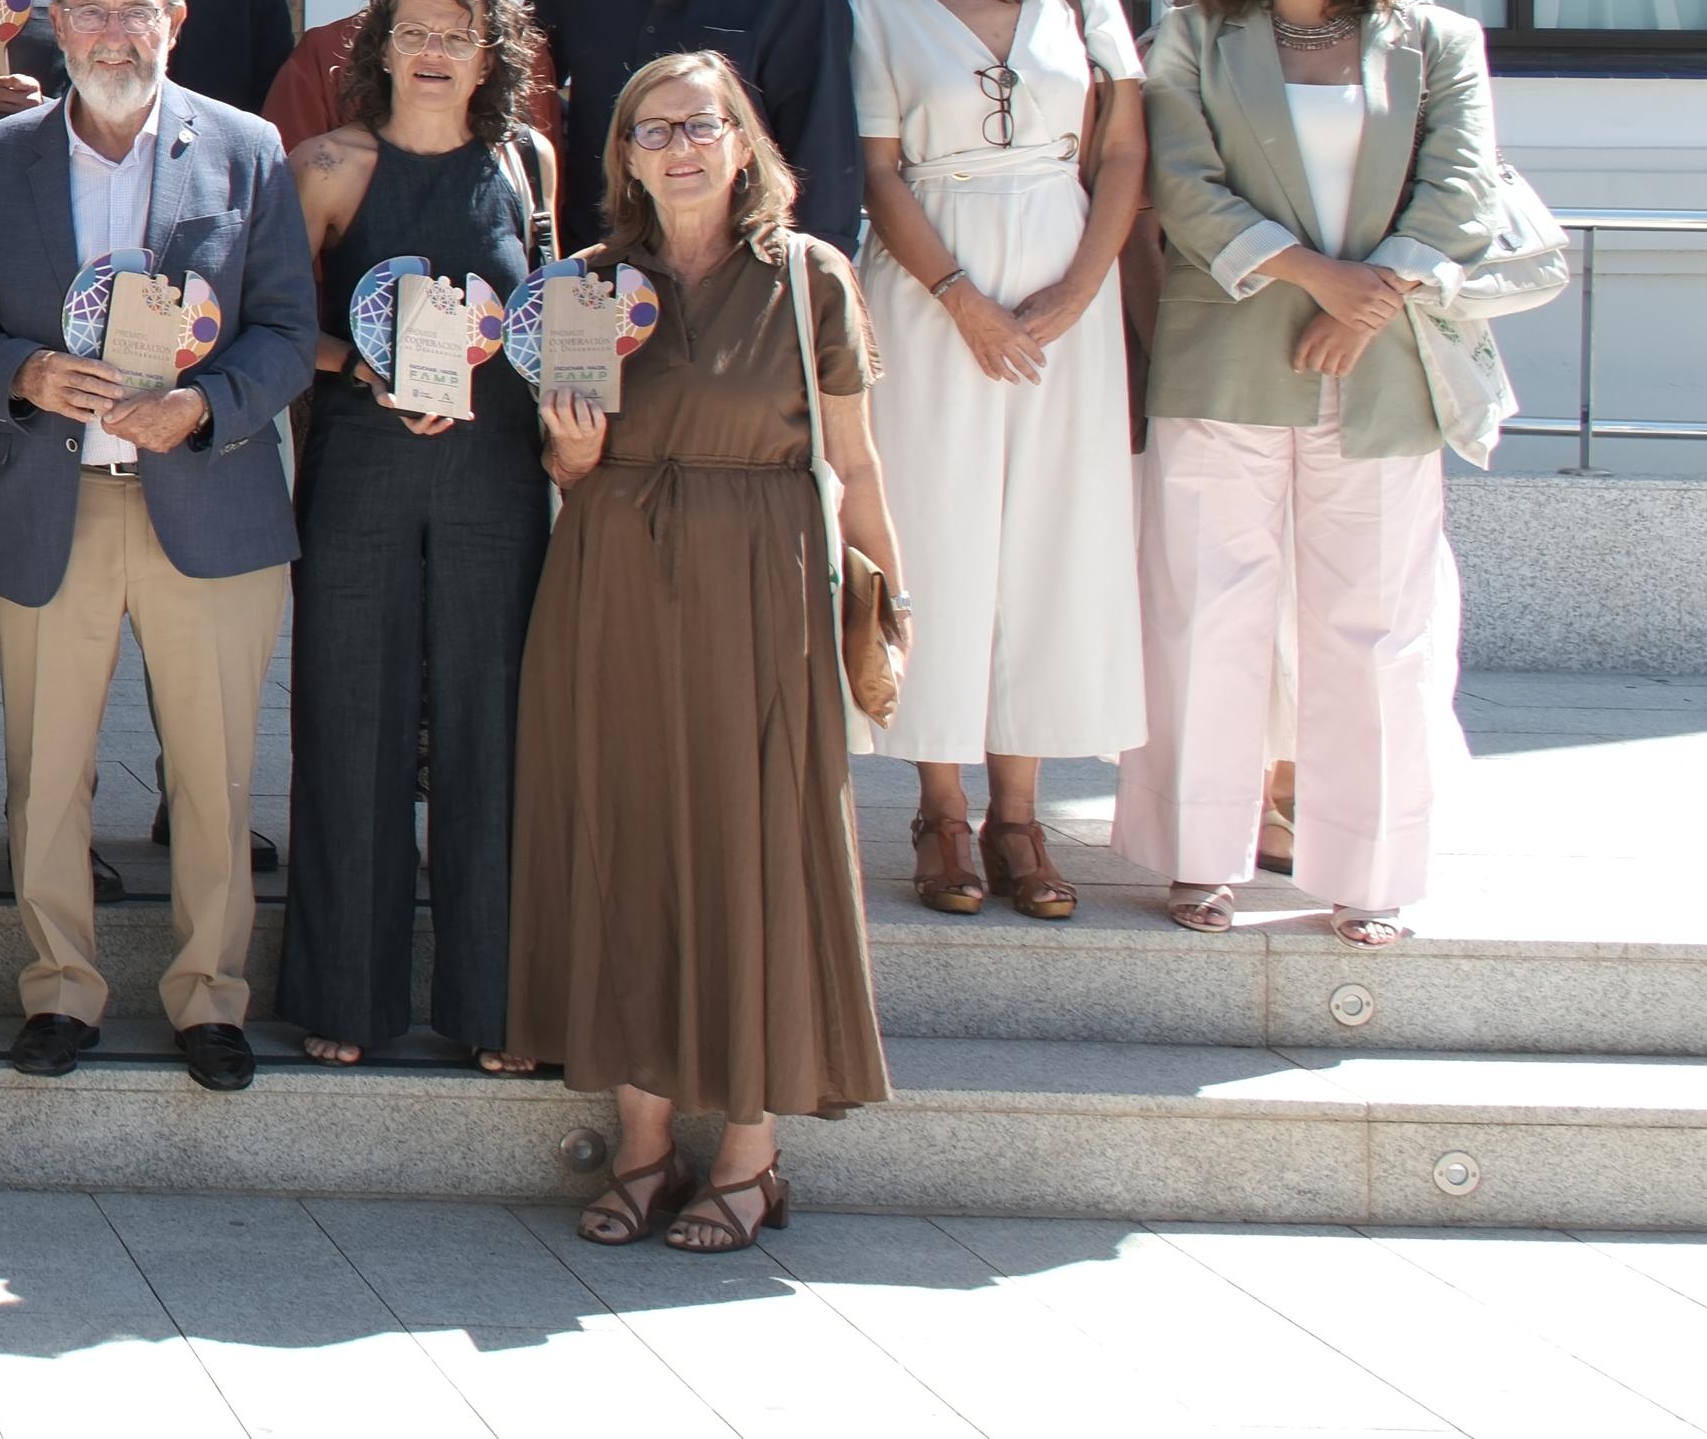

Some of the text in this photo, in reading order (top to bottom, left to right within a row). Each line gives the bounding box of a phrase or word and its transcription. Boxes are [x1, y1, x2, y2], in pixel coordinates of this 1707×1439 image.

[410, 371, 459, 384] FAMP
[555, 371, 607, 380] FAMP
[125, 376, 164, 388] AMP
